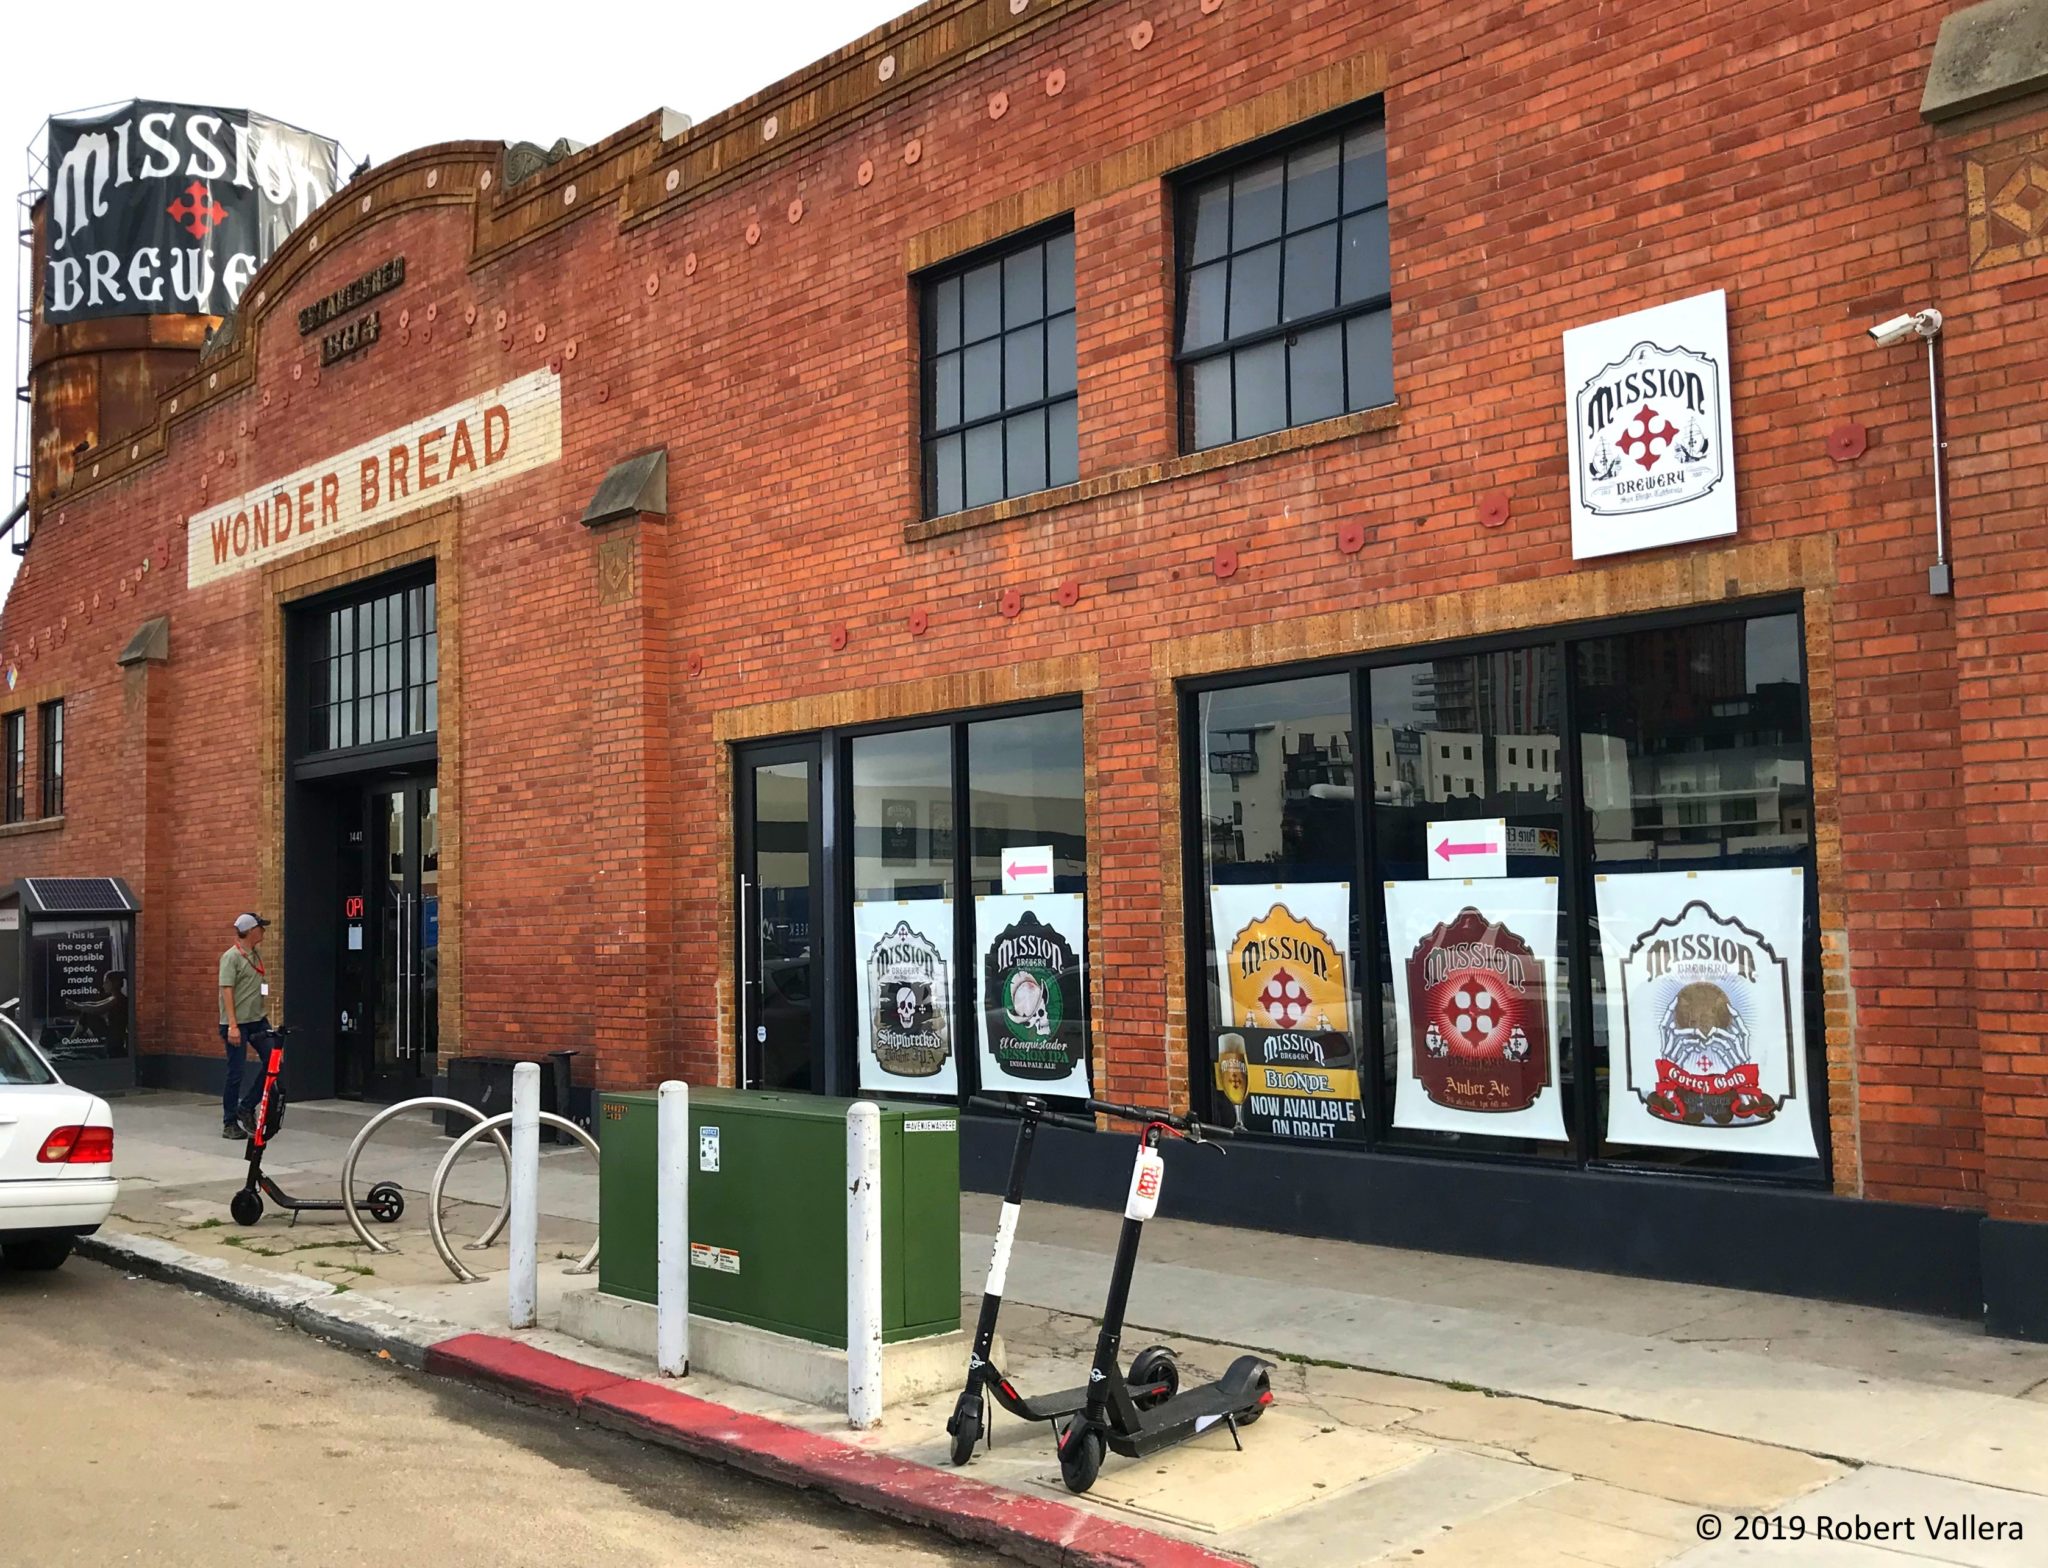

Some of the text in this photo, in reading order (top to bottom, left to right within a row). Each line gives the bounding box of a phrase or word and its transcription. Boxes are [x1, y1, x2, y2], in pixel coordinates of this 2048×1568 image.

[54, 112, 329, 250] MISSION
[49, 247, 268, 314] BREWE
[1588, 369, 1705, 440] MISSION
[211, 404, 510, 565] WONDER BREAD
[1616, 471, 1685, 495] BREWERY
[346, 898, 364, 917] OP
[67, 931, 94, 939] This is
[57, 941, 104, 952] the age of
[998, 935, 1063, 974] MISSION
[56, 953, 104, 964] impossible
[877, 943, 935, 980] MISSION
[1016, 957, 1047, 967] BREWERY
[1242, 936, 1328, 981] MISSION
[1424, 942, 1525, 993] MISSION
[1647, 933, 1756, 983] MISSION
[1677, 963, 1729, 974] BREWERY
[63, 964, 98, 975] speeds,
[67, 975, 94, 984] made
[60, 987, 100, 997] possible.
[62, 1037, 98, 1045] Qualcomm
[877, 1029, 941, 1050] Shipwrecked
[999, 1037, 1068, 1052] El Conquistador
[1264, 1033, 1325, 1067] MISSION
[1000, 1049, 1070, 1063] SESSION IPA
[1027, 1061, 1043, 1069] PALE
[1264, 1068, 1335, 1094] BLONDE
[1444, 1076, 1511, 1099] Amber Ale
[1668, 1067, 1746, 1093] Cortez Gold
[1250, 1095, 1356, 1122] NOW AVAILABLE
[1272, 1119, 1335, 1138] ON DRAFT
